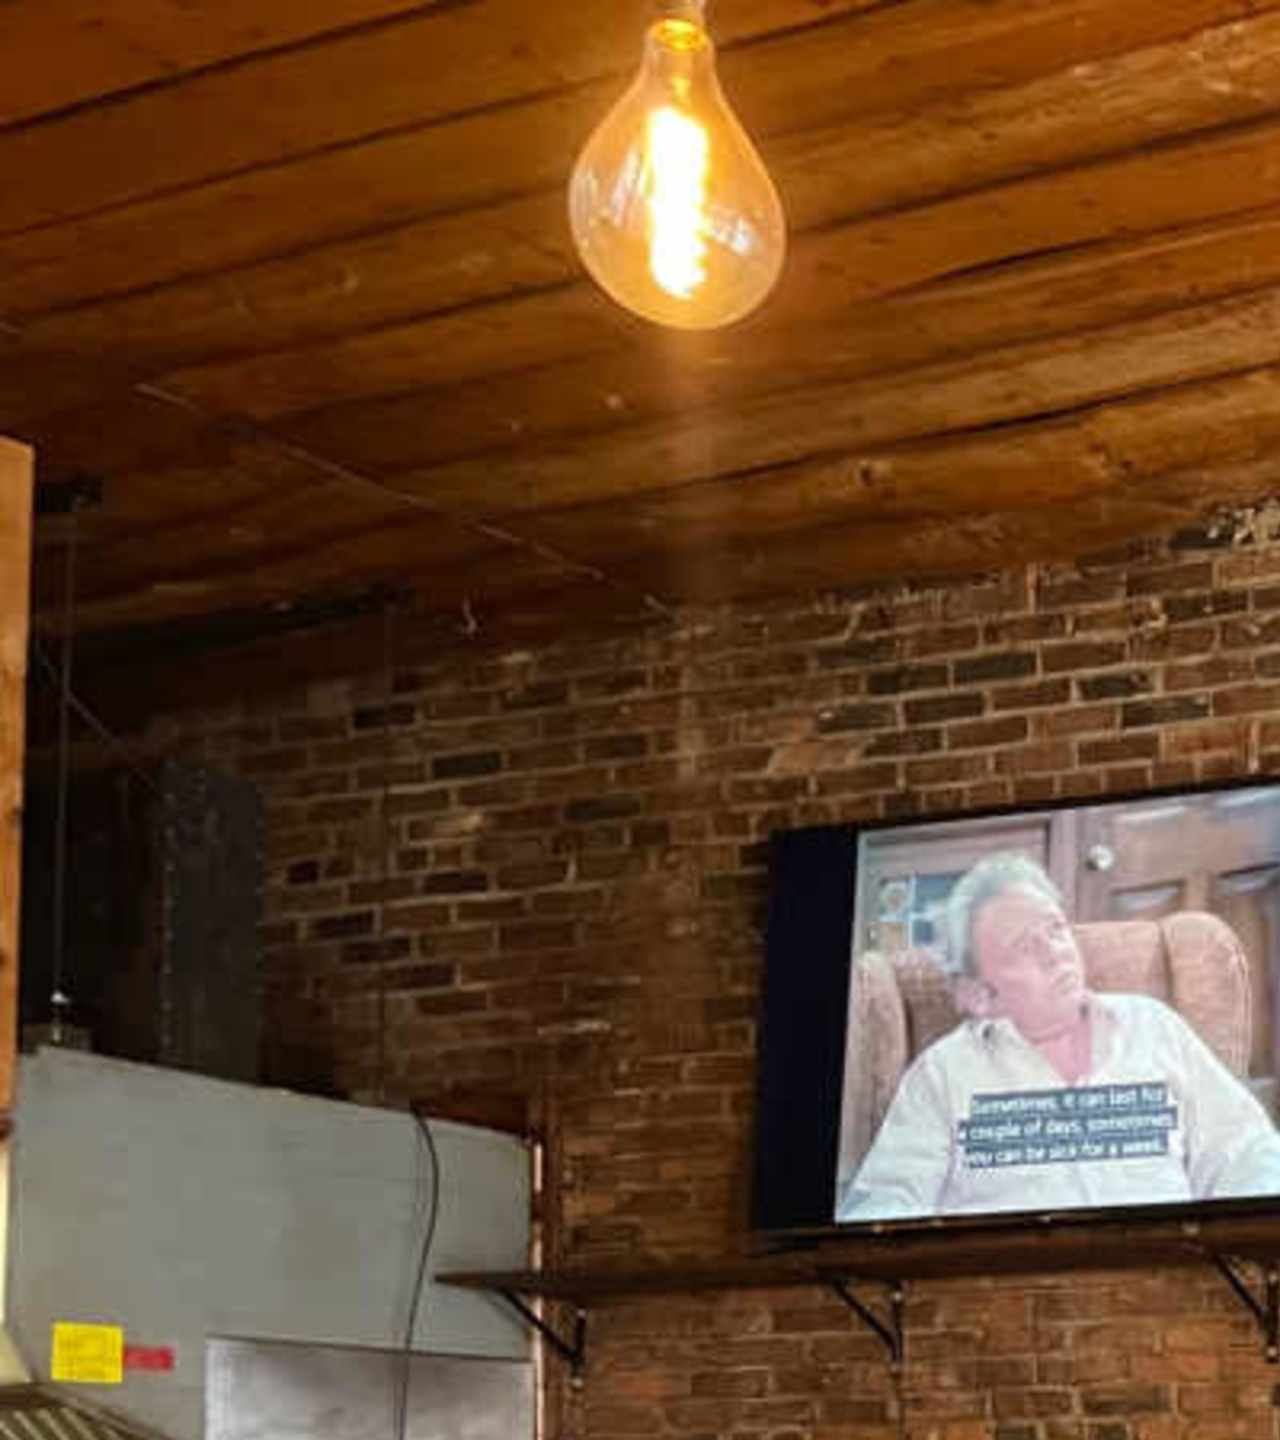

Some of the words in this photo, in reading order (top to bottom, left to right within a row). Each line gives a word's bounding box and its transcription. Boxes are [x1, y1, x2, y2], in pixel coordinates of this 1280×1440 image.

[1108, 1087, 1138, 1106] last
[1140, 1085, 1163, 1102] for
[969, 1120, 1022, 1141] couple
[1023, 1119, 1042, 1135] of
[995, 1149, 1022, 1162] can
[1025, 1144, 1045, 1160] be
[1080, 1139, 1104, 1156] for
